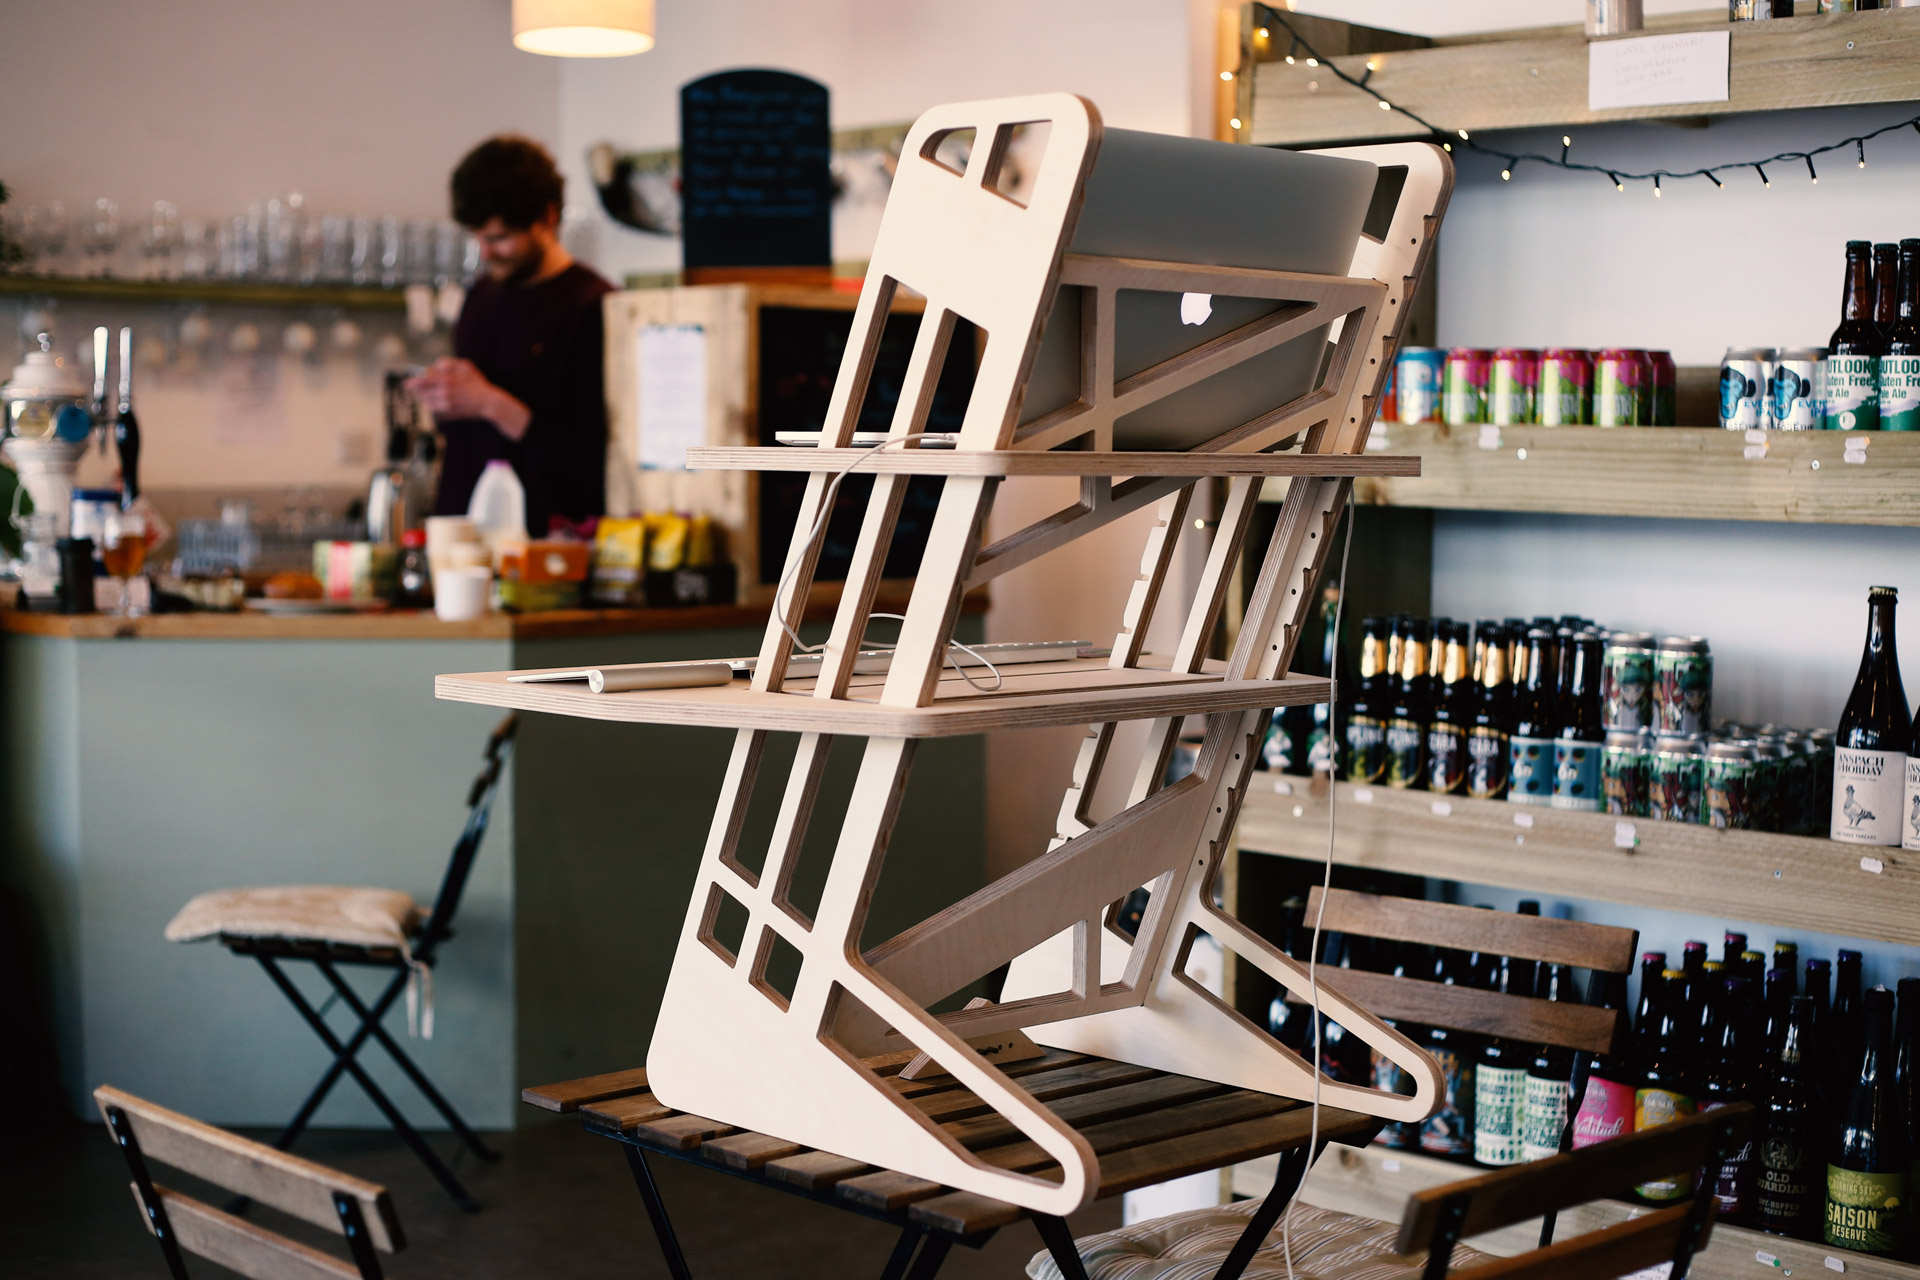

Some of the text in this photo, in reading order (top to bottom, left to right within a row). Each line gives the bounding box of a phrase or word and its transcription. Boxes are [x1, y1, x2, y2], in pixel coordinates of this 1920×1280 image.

[1828, 359, 1870, 374] UTLOOK
[1880, 359, 1920, 374] UTLOO
[1835, 388, 1850, 398] Ale
[1892, 388, 1907, 399] Ale
[1766, 1170, 1790, 1183] OLD
[1828, 1202, 1878, 1230] SAISON
[1832, 1224, 1867, 1241] RESERVE
